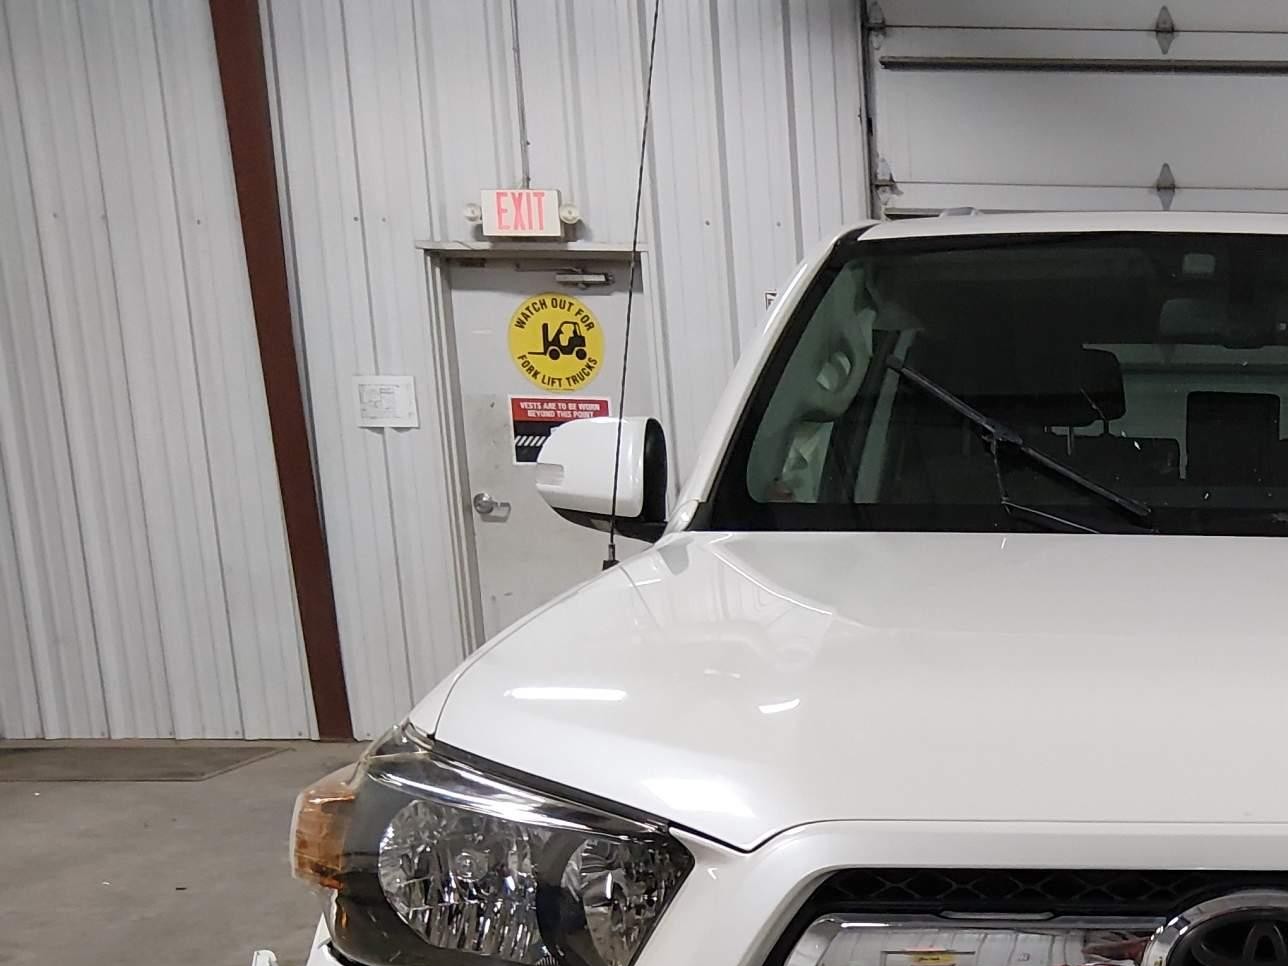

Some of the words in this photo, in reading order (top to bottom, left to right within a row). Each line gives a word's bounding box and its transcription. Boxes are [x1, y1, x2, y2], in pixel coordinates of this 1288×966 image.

[496, 192, 544, 230] EXIT
[514, 298, 548, 329] WATCH
[551, 297, 574, 312] OUT
[574, 308, 595, 331] FOR
[517, 354, 541, 380] FORK
[541, 374, 563, 388] LIFT
[565, 357, 598, 387] TRUCKS
[543, 402, 557, 410] ARE
[568, 403, 577, 411] BE
[578, 403, 600, 411] WORN
